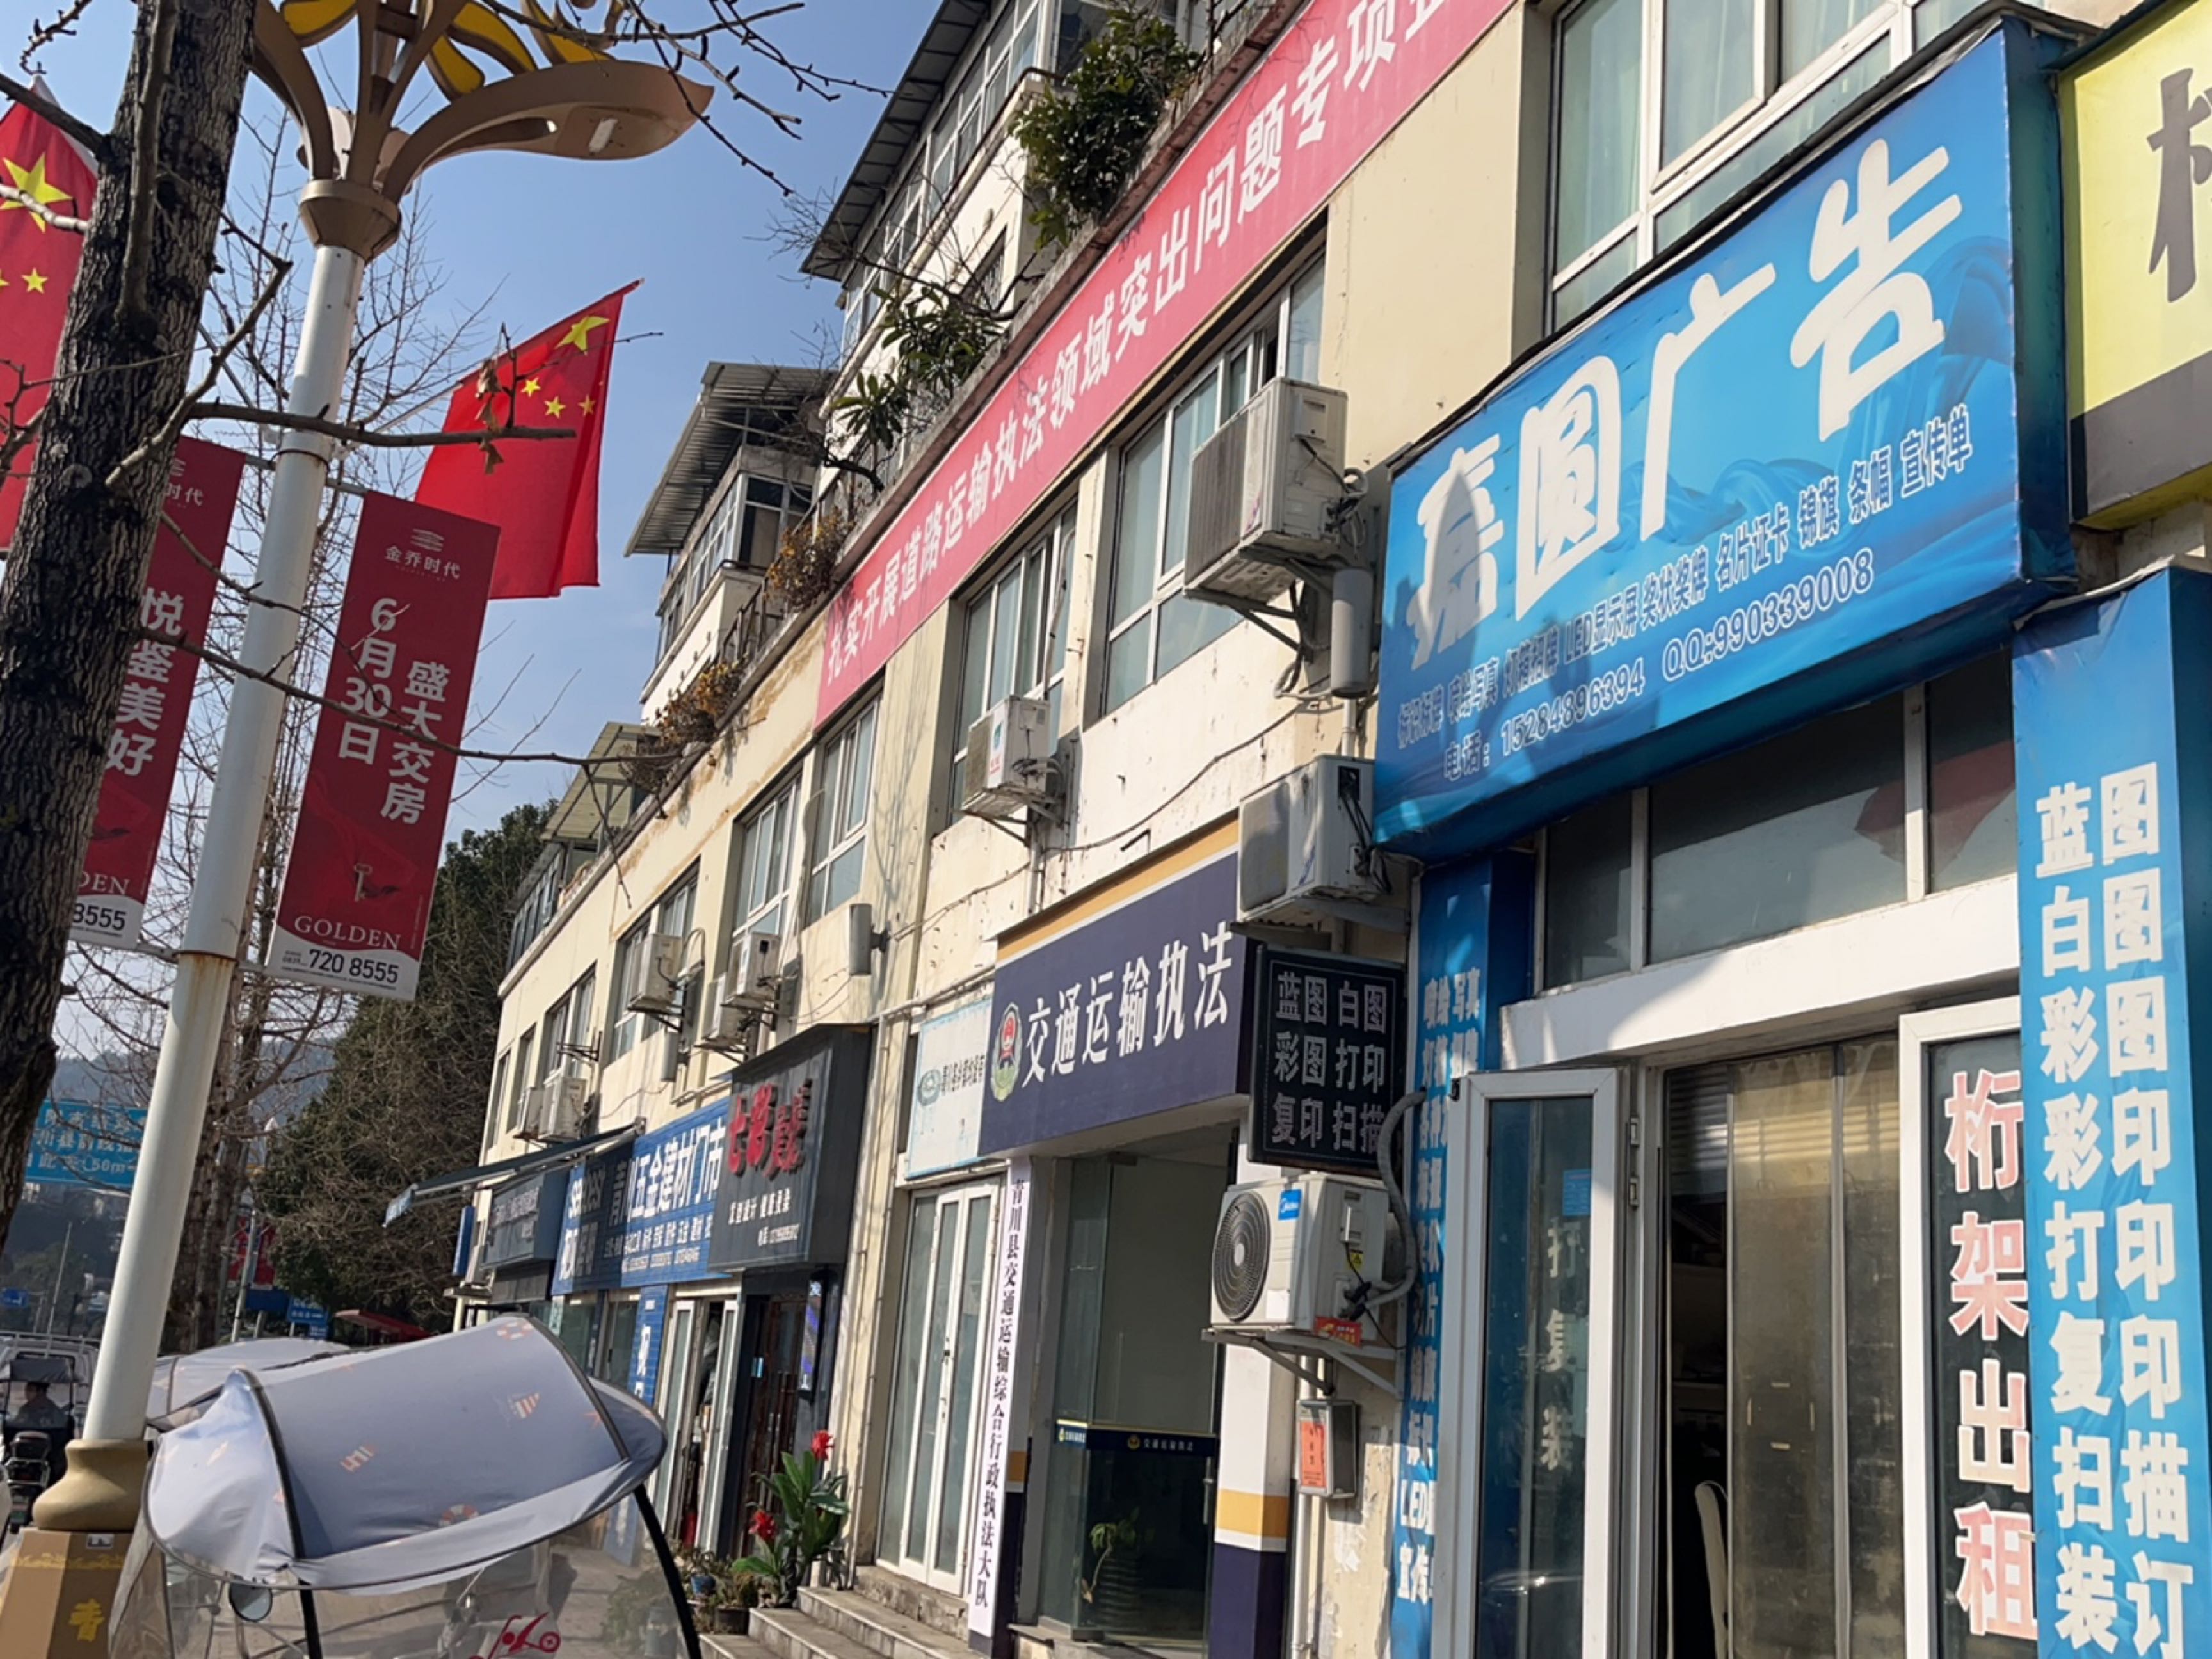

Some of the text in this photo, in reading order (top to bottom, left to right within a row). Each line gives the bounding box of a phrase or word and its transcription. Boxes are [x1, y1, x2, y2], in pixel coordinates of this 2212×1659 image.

[385, 545, 460, 579] 金乔时代
[1563, 582, 1640, 664] LED显示屏
[1715, 502, 1790, 592] 名片证卡
[1798, 476, 1839, 549] 锦旗
[1848, 445, 1892, 525] 条幅
[1900, 403, 1973, 497] 宣传单
[1663, 547, 1875, 682] QQ:990339008
[338, 598, 397, 765] 6月30日
[1500, 657, 1646, 757] 15284896394
[380, 660, 450, 824] 盛大交房
[2035, 761, 2160, 878] 蓝图
[294, 915, 401, 950] GOLDEN
[309, 949, 344, 973] 720
[349, 958, 399, 983] 8555
[2042, 867, 2163, 978] 白图
[1022, 921, 1232, 1088] 交通运输执法
[1276, 970, 1387, 1034] 蓝图 白图
[2040, 975, 2168, 1084] 彩图
[1274, 1031, 1386, 1094] 彩图 打印
[1272, 1092, 1324, 1148] 复印
[1332, 1100, 1386, 1154] 扫描
[2044, 1087, 2172, 1190] 彩印
[2045, 1199, 2176, 1301] 打印
[975, 1179, 1024, 1608] 青川县交通运输综合行政执法大队
[1944, 1068, 2037, 1640] 桁架出租
[2050, 1311, 2182, 1420] 复印
[2053, 1426, 2188, 1543] 扫描
[2055, 1541, 2194, 1659] 装订
